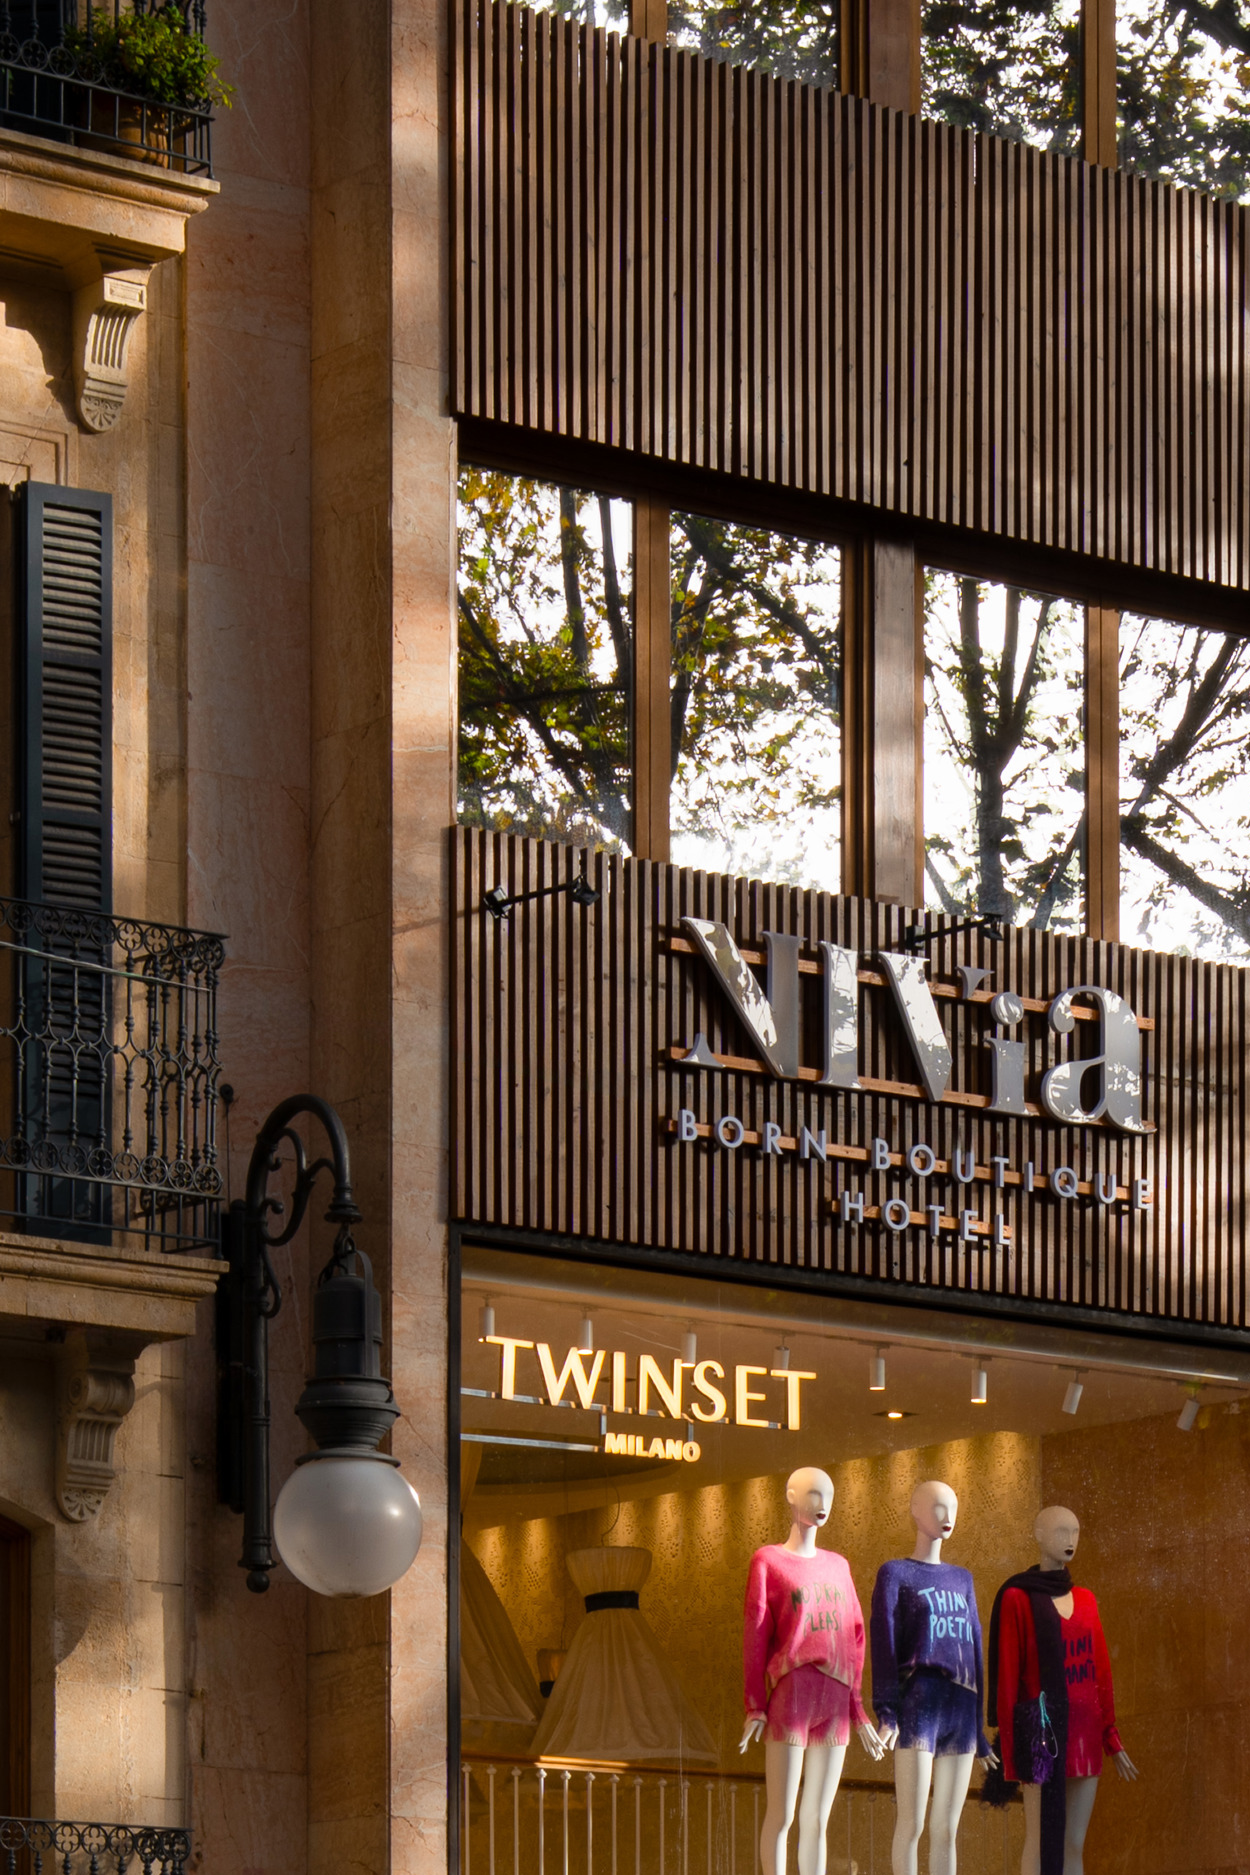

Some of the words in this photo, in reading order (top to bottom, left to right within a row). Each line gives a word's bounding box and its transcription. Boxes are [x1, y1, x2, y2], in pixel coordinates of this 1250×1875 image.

[677, 1109, 827, 1162] BORN
[871, 1138, 1153, 1210] BOUTIQUE
[840, 1190, 1011, 1246] HOTEL
[486, 1335, 817, 1431] TWINSET
[604, 1432, 701, 1463] MILANO
